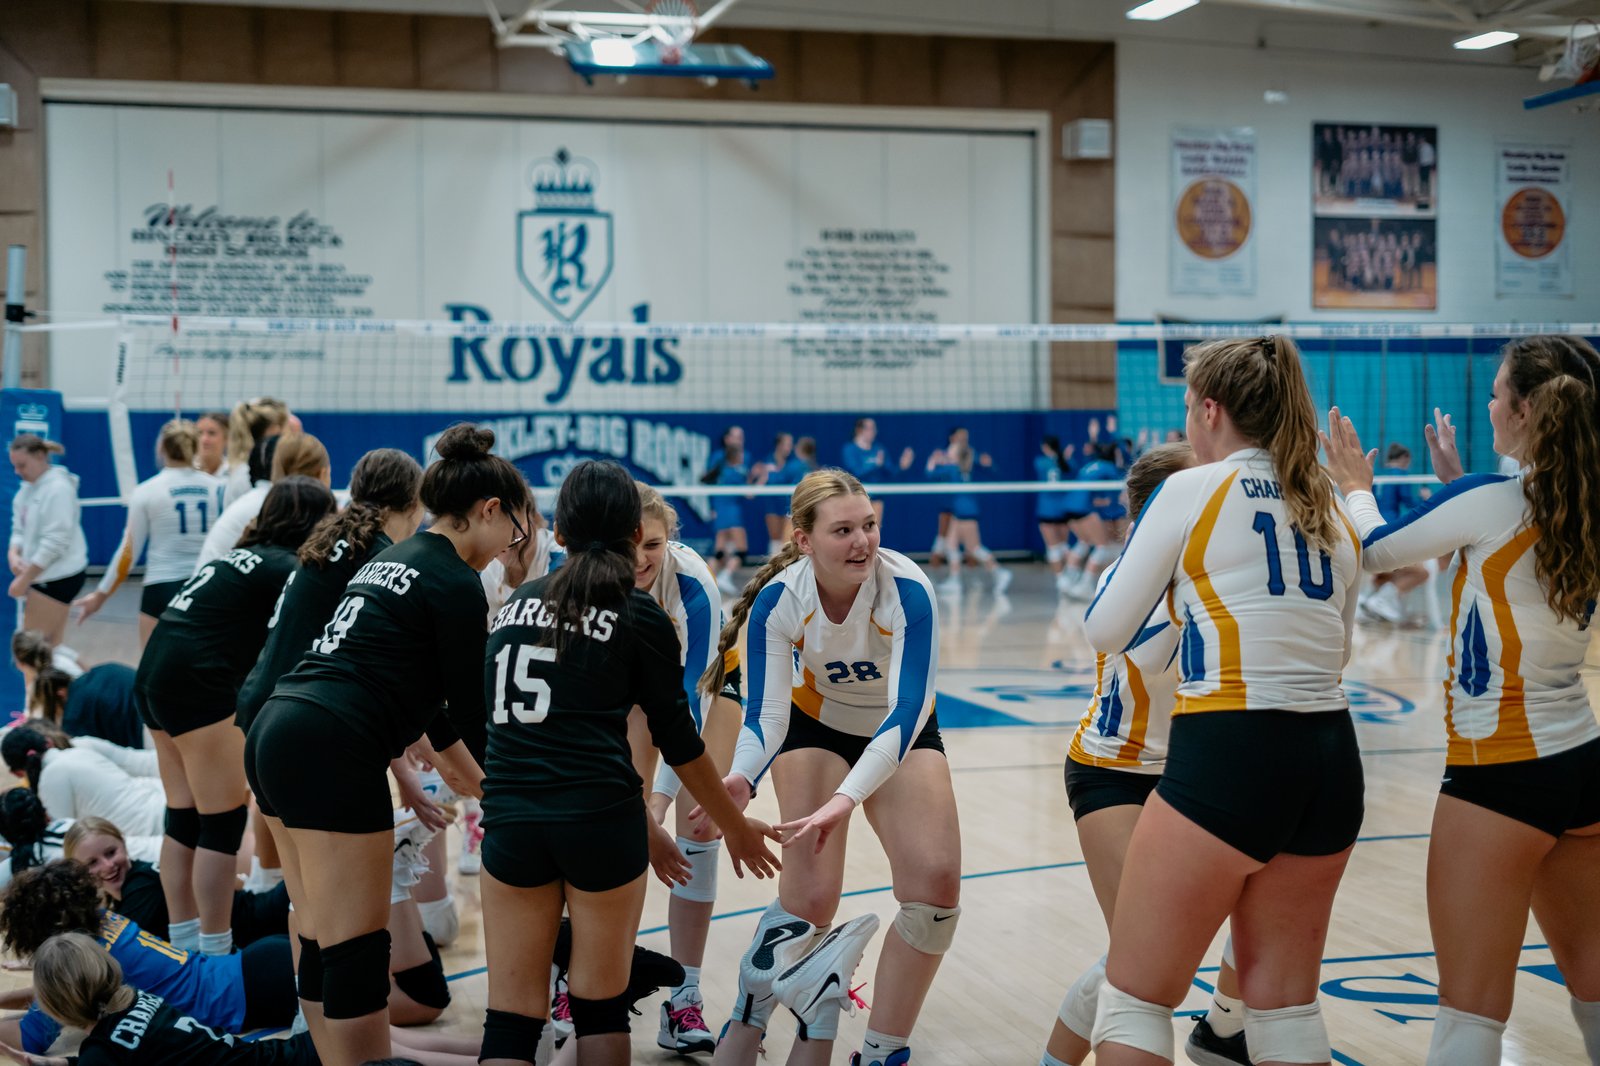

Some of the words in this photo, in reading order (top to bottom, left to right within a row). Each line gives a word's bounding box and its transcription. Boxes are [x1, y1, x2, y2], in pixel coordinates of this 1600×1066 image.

[444, 303, 684, 404] Royals
[175, 501, 208, 534] 11
[1252, 510, 1334, 602] 10
[492, 643, 558, 725] 15
[824, 660, 884, 684] 28
